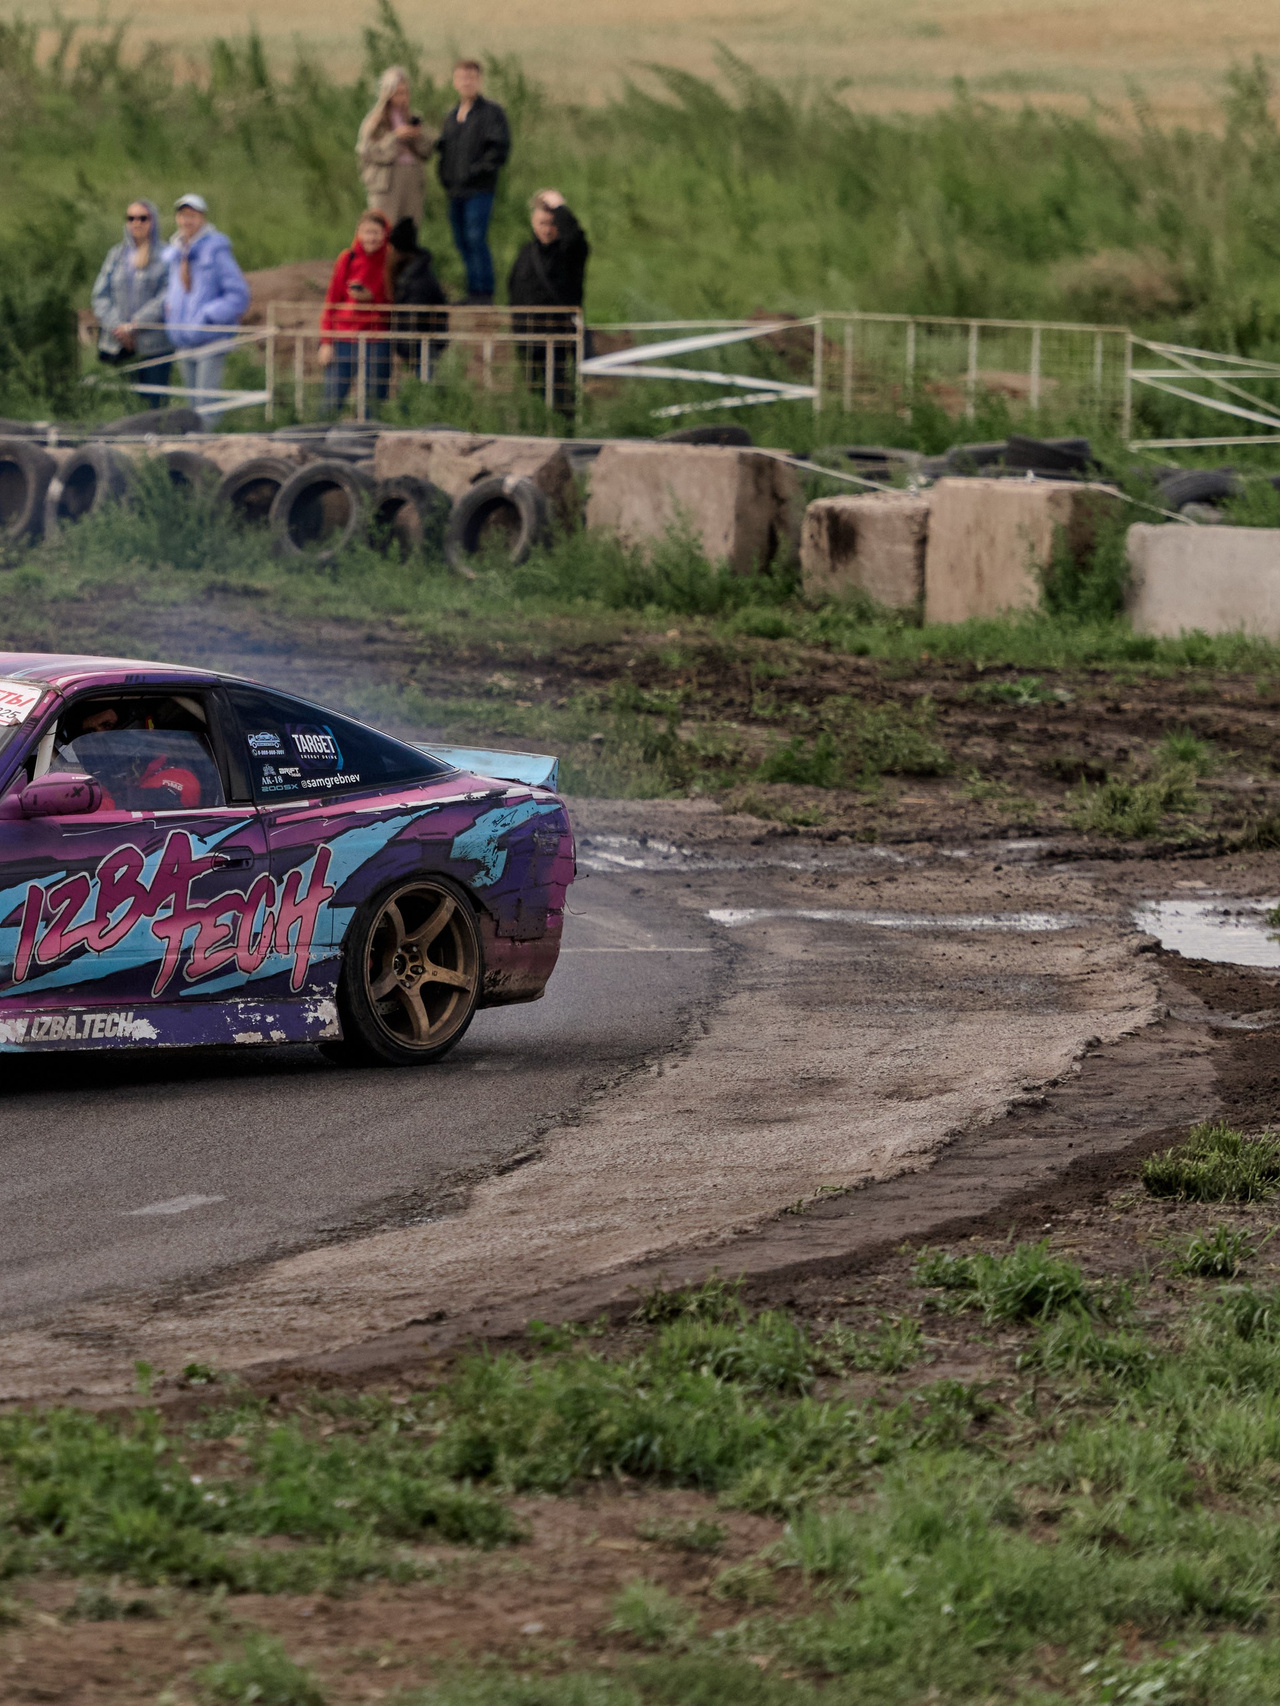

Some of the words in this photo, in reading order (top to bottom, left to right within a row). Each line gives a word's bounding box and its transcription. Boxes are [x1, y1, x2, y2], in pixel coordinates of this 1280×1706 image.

[292, 735, 335, 753] TARGET
[301, 773, 360, 788] @samgrebnev
[12, 830, 231, 984] IZBA
[151, 843, 335, 998] TECH
